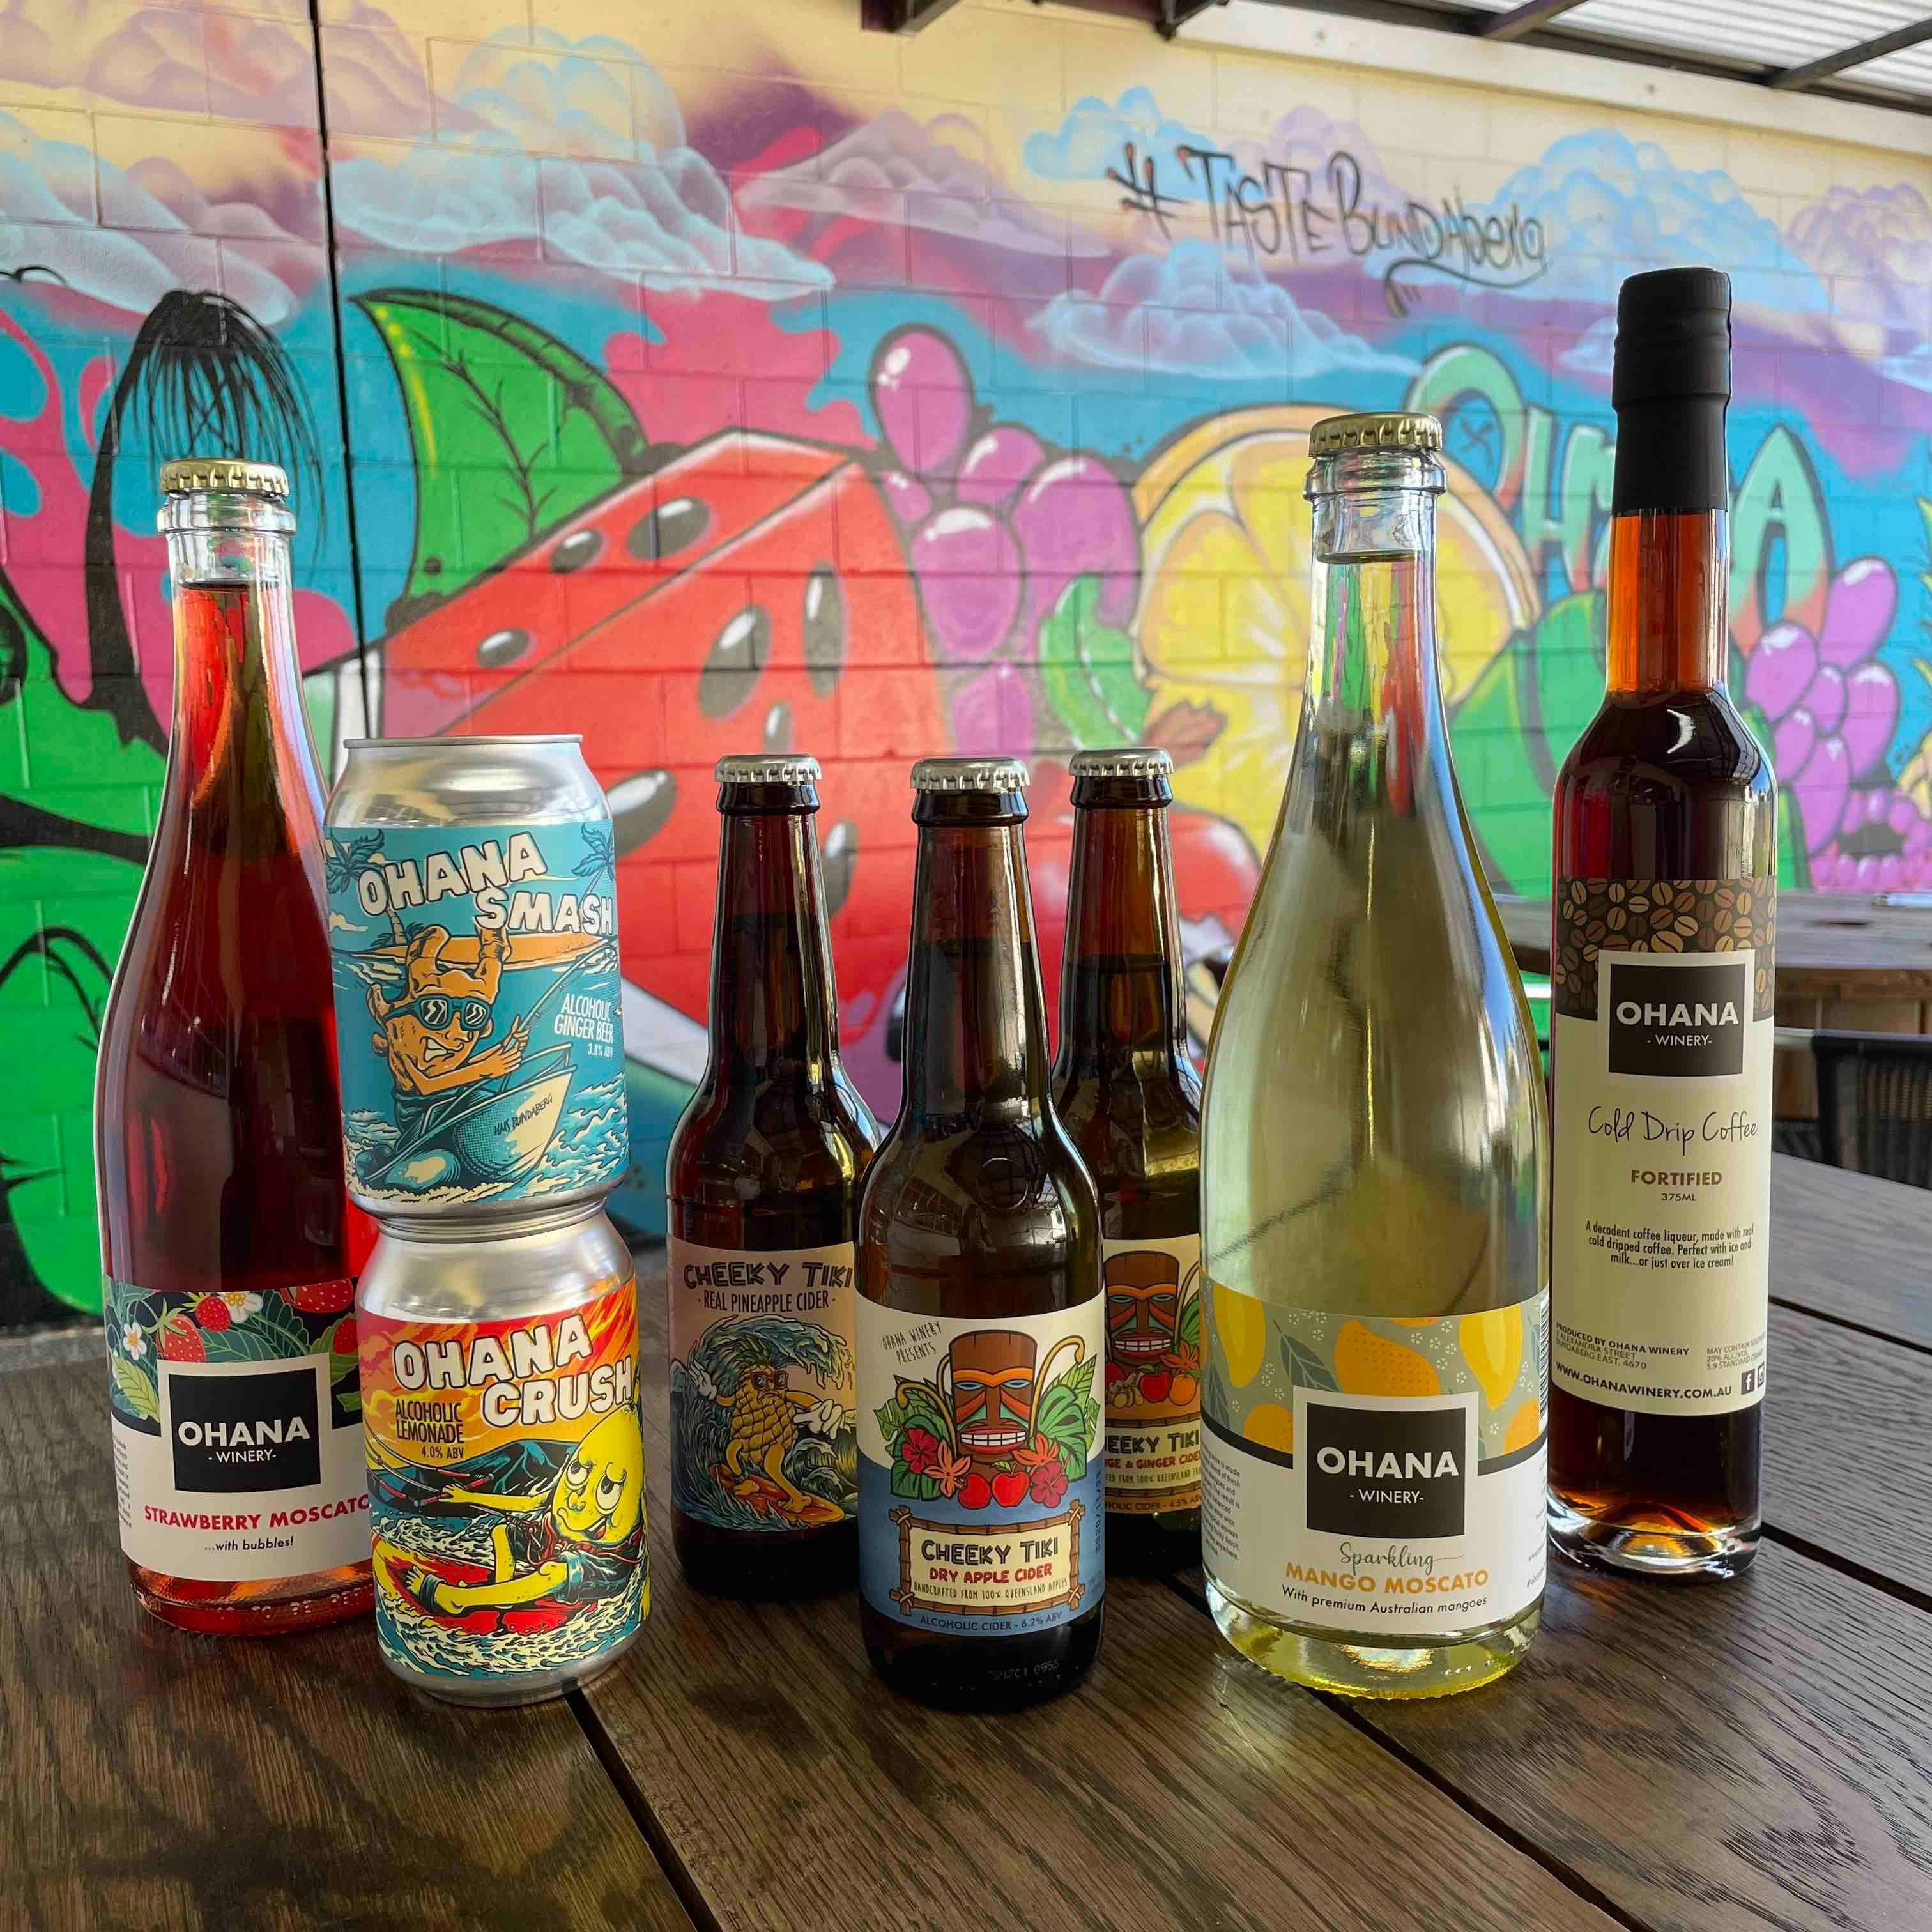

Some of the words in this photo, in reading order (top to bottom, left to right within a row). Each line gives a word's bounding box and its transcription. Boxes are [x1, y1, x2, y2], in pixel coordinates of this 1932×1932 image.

[358, 831, 548, 916] OHANA
[475, 887, 613, 937] SMASH
[561, 993, 611, 1022] ALCOHOLIC
[1616, 1001, 1738, 1027] OHANA
[554, 1015, 595, 1040] GINGER
[596, 1021, 614, 1043] BEER
[1588, 1105, 1635, 1143] Cold
[1641, 1111, 1695, 1156] Drip
[1702, 1110, 1758, 1142] Coffee
[1631, 1169, 1722, 1186] FORTIFIED
[1661, 1193, 1697, 1202] 375ML
[1586, 1220, 1591, 1232] A
[1593, 1221, 1630, 1238] decadent
[1633, 1227, 1661, 1241] coffee
[1664, 1229, 1698, 1244] liqueur,
[1701, 1228, 1724, 1241] made
[1727, 1225, 1741, 1238] with
[1589, 1234, 1604, 1247] cold
[1607, 1236, 1640, 1252] dripped
[1643, 1242, 1674, 1255] coffee.
[1678, 1243, 1707, 1255] Perfect
[1710, 1242, 1726, 1254] with
[1729, 1242, 1738, 1252] ice
[1740, 1237, 1751, 1250] and
[1652, 1256, 1667, 1270] just
[1671, 1259, 1690, 1268] over
[1693, 1257, 1705, 1268] ice
[1707, 1254, 1734, 1268] cream!
[684, 1261, 790, 1289] CHEEKY
[802, 1261, 854, 1289] TIKI
[703, 1295, 727, 1312] REAL
[731, 1292, 793, 1314] PINEAPPLE
[796, 1290, 829, 1312] CIDER
[908, 1321, 942, 1342] WINERY
[1556, 1321, 1593, 1342] PRODUCED
[1595, 1338, 1606, 1346] BY
[1609, 1340, 1646, 1353] OHANA
[1649, 1346, 1689, 1356] WINERY
[393, 1313, 594, 1391] OHANA
[896, 1341, 936, 1365] PRESENTS
[1604, 1347, 1636, 1360] STREET
[1623, 1360, 1646, 1370] 4670
[481, 1355, 635, 1428] CRUSH
[1556, 1361, 1732, 1399] WWW.OHANAWINERY.COM.AU
[395, 1399, 463, 1423] ALCOHOLIC
[178, 1416, 311, 1447] OHANA
[396, 1419, 465, 1444] LEMONADE
[1105, 1435, 1160, 1454] EEKY
[1167, 1430, 1199, 1452] TIKI
[422, 1446, 443, 1458] 4.0%
[447, 1447, 464, 1459] ABV
[1136, 1456, 1176, 1469] GINGER
[1317, 1446, 1459, 1479] OHANA
[144, 1505, 261, 1531] STRAWBERRY
[242, 1535, 294, 1551] bubbles!
[921, 1539, 1011, 1566] CHEEKY
[1020, 1536, 1058, 1563] TIKI
[1339, 1541, 1466, 1575] Sparkling
[930, 1567, 958, 1583] DRY
[963, 1570, 1009, 1584] APPLE
[1015, 1563, 1053, 1582] CIDER
[1285, 1562, 1376, 1593] MANGO
[1384, 1569, 1489, 1595] MOSCATO
[914, 1581, 957, 1598] HANDCRAFTED
[961, 1589, 977, 1600] FROM
[981, 1589, 1001, 1600] 100%
[1005, 1583, 1046, 1598] QUEENSLAND
[1048, 1577, 1068, 1591] APPLES
[1282, 1584, 1308, 1603] With
[1312, 1595, 1366, 1613] premium
[1370, 1598, 1434, 1614] Australian
[1437, 1596, 1487, 1613] mangoes
[920, 1615, 980, 1631] ALCOHOLIC
[981, 1620, 1011, 1631] CIDER
[1046, 1611, 1062, 1624] ABV
